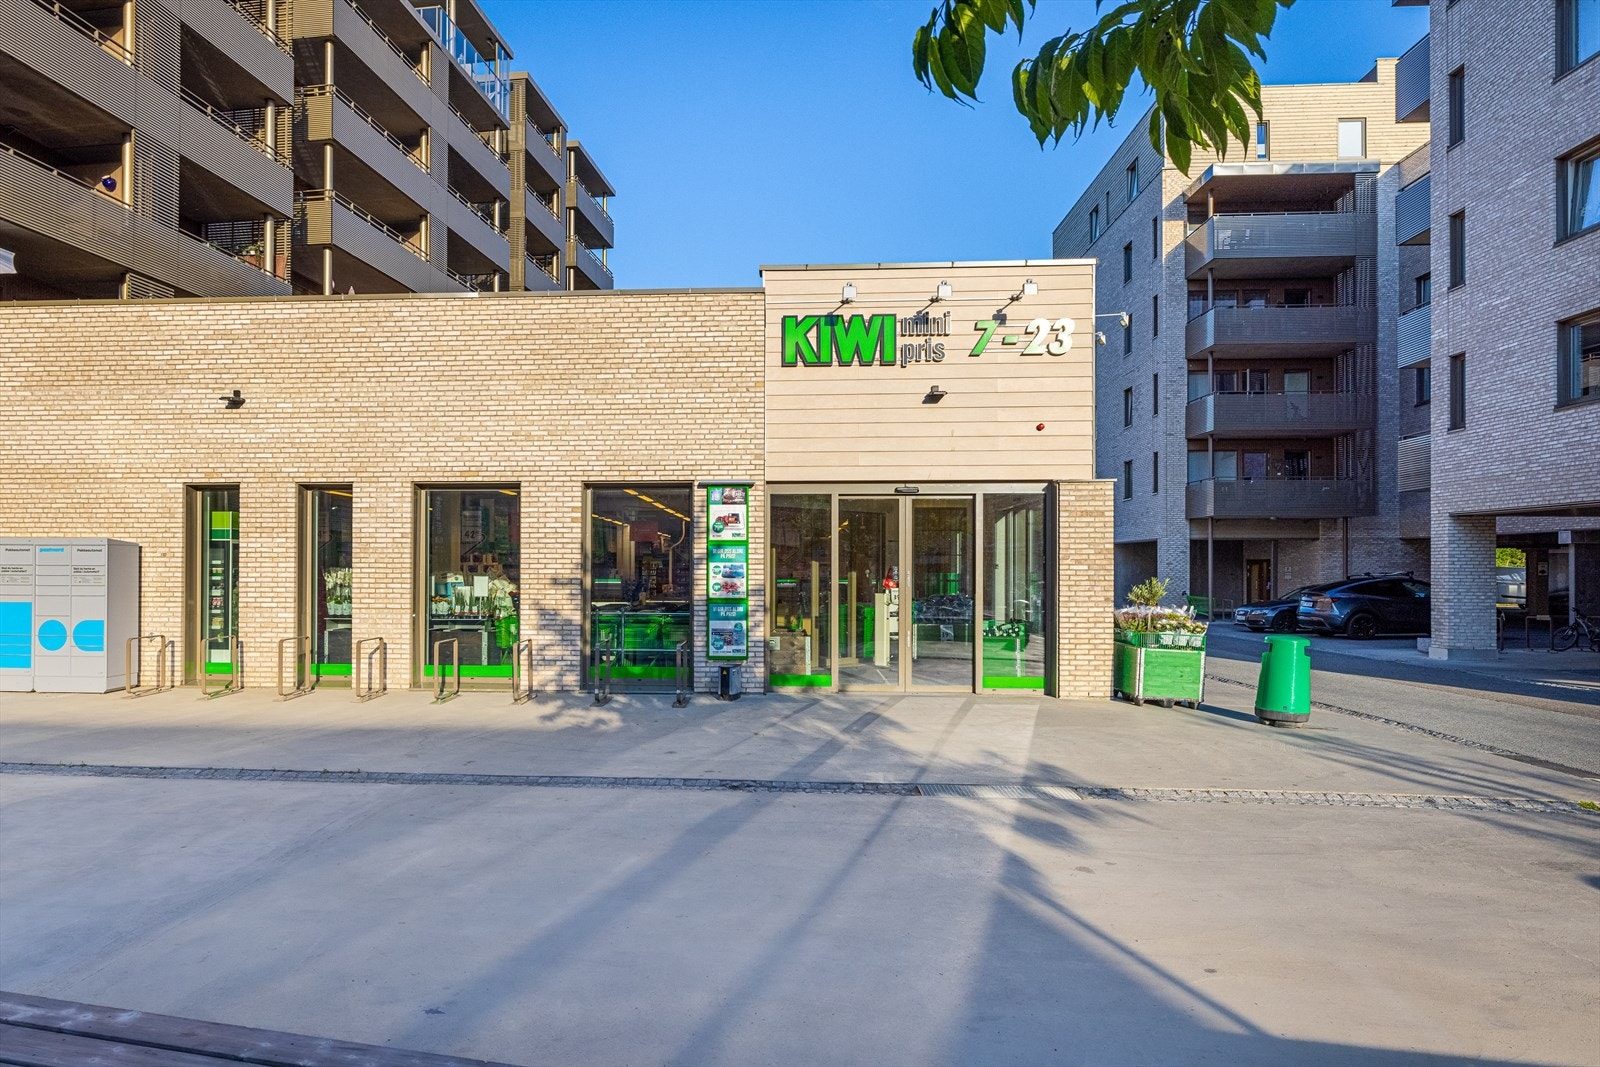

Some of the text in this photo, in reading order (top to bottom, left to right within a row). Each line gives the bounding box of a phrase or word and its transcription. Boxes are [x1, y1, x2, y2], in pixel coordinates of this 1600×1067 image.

[782, 313, 897, 367] KIWI
[902, 311, 951, 338] mini
[969, 317, 1075, 358] 7-23
[902, 338, 946, 369] pris
